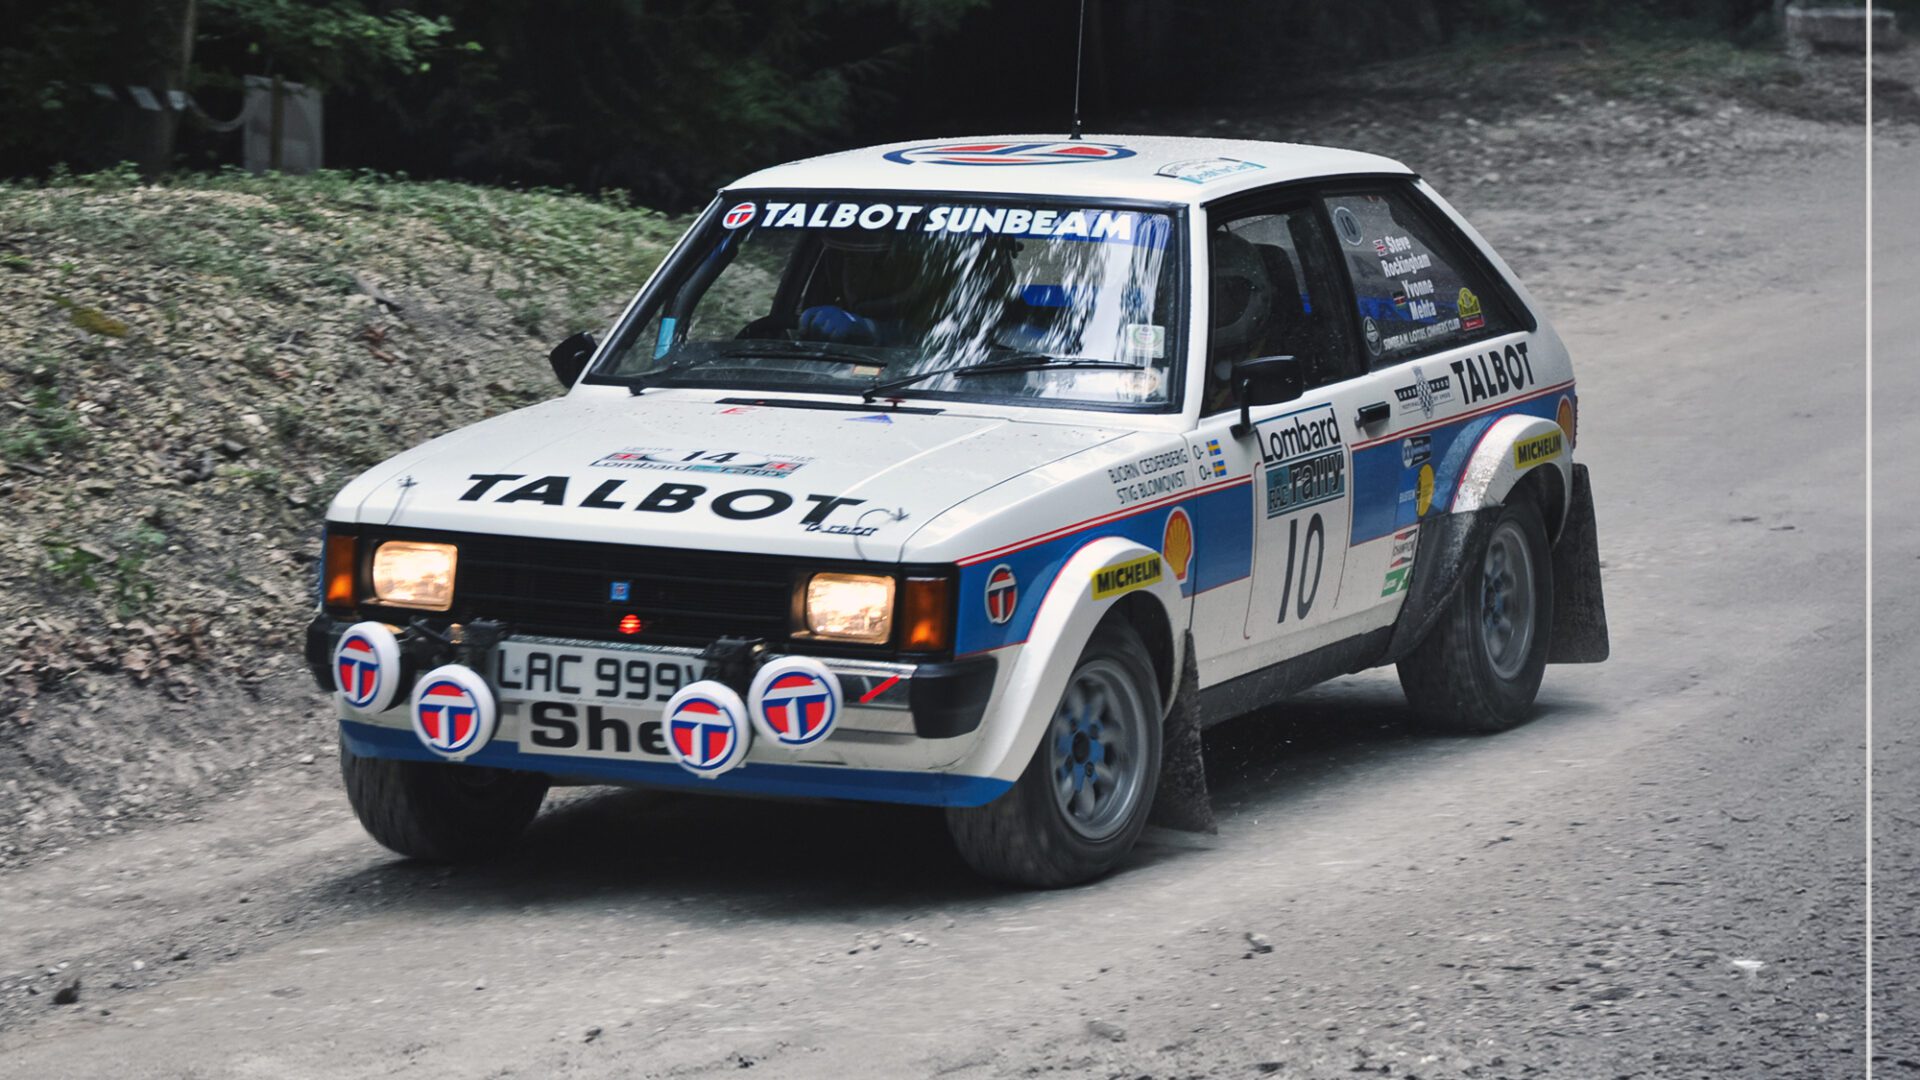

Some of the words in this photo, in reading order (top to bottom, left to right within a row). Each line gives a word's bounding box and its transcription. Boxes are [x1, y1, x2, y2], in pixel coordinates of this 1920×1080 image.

[761, 203, 923, 230] TALBOT
[923, 206, 1132, 240] SUNBEAM
[1385, 235, 1411, 254] Steve
[1381, 252, 1432, 278] Rockingham
[1401, 279, 1435, 298] Yvonne
[1409, 299, 1437, 320] Mehta
[1450, 342, 1534, 404] TALBOT
[1255, 408, 1341, 463] Lombard
[1516, 433, 1562, 464] MICHELIN
[588, 459, 693, 472] Lombard
[681, 450, 739, 463] 14
[1290, 452, 1343, 505] rally
[459, 473, 867, 526] TALBOT
[1096, 556, 1163, 594] MICHELIN
[1277, 512, 1325, 624] 10
[499, 650, 582, 694] LAC
